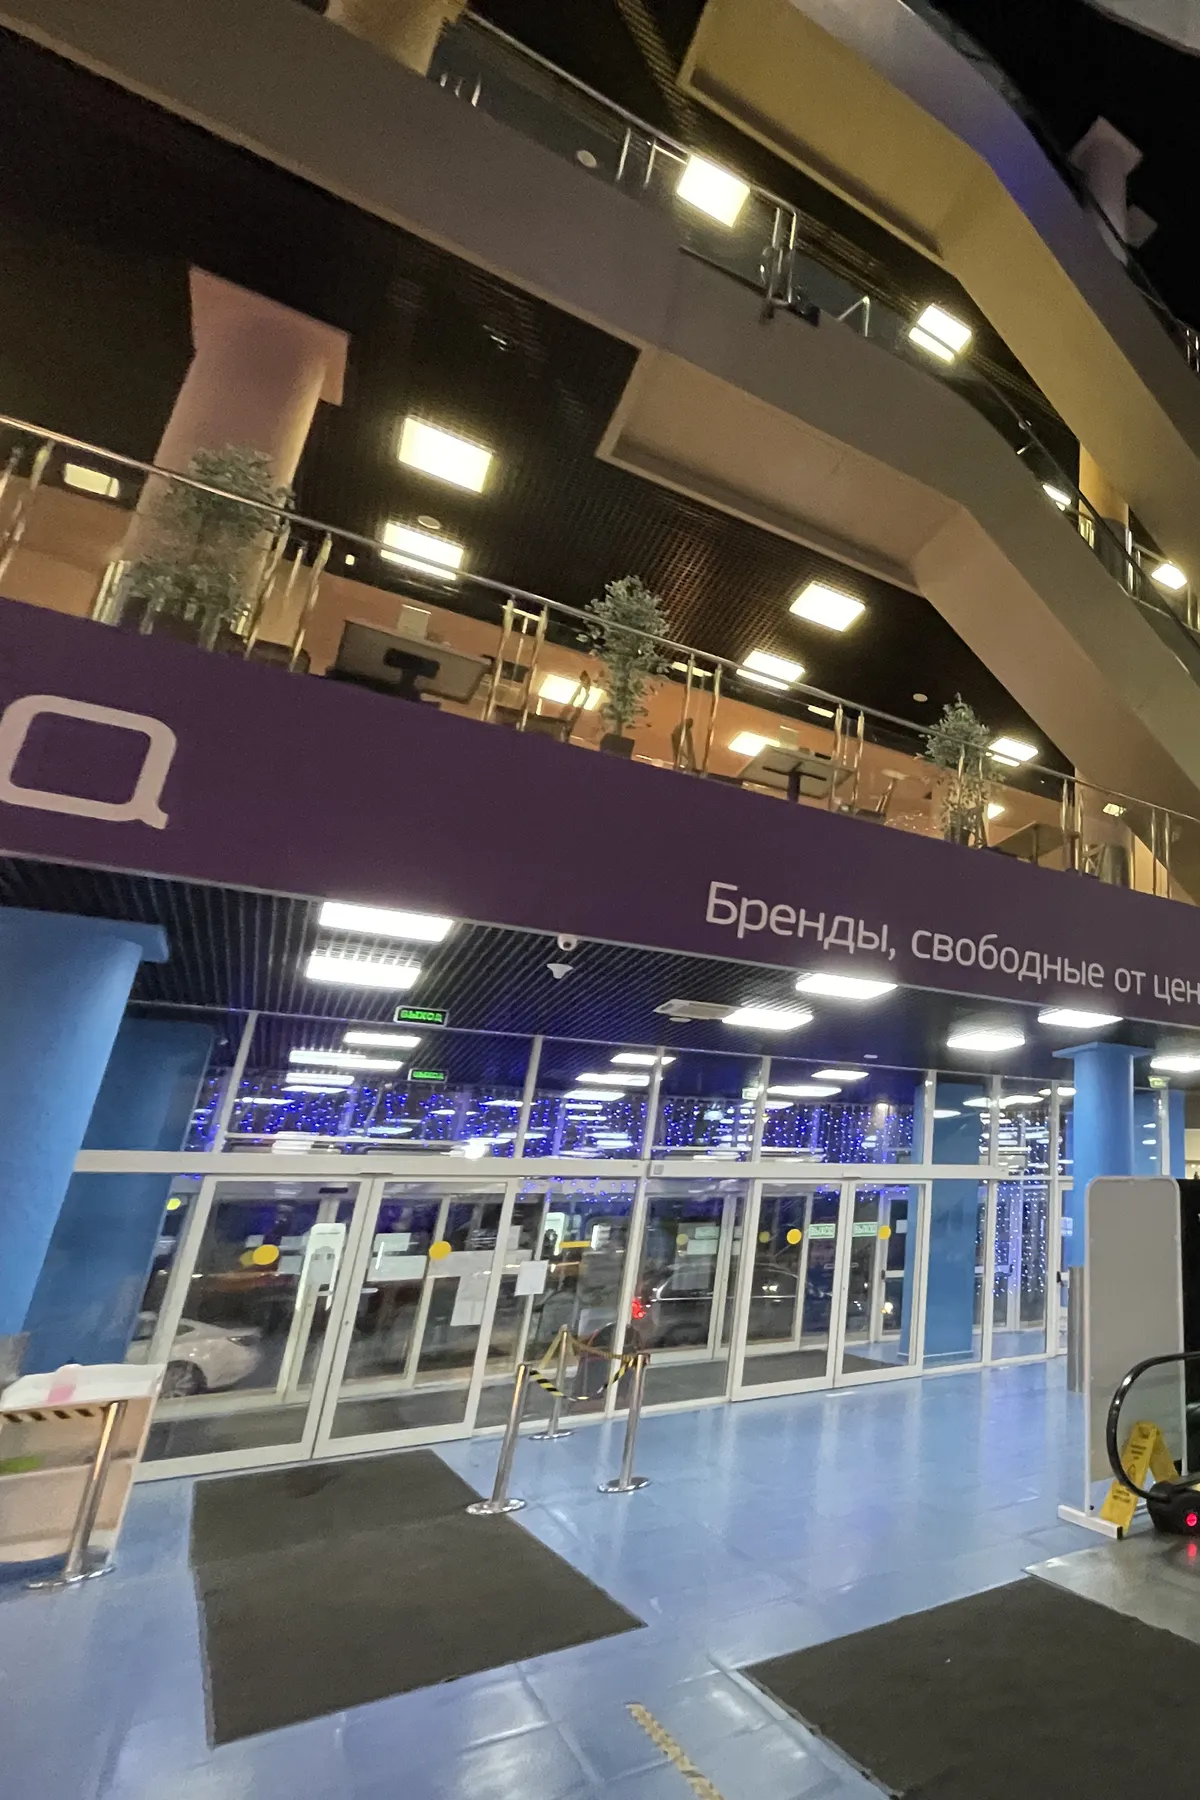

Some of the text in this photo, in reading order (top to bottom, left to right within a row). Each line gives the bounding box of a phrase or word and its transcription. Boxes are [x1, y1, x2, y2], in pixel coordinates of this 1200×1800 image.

[706, 881, 896, 961] Бренды,
[911, 929, 1105, 988] свободные
[1114, 967, 1146, 995] от
